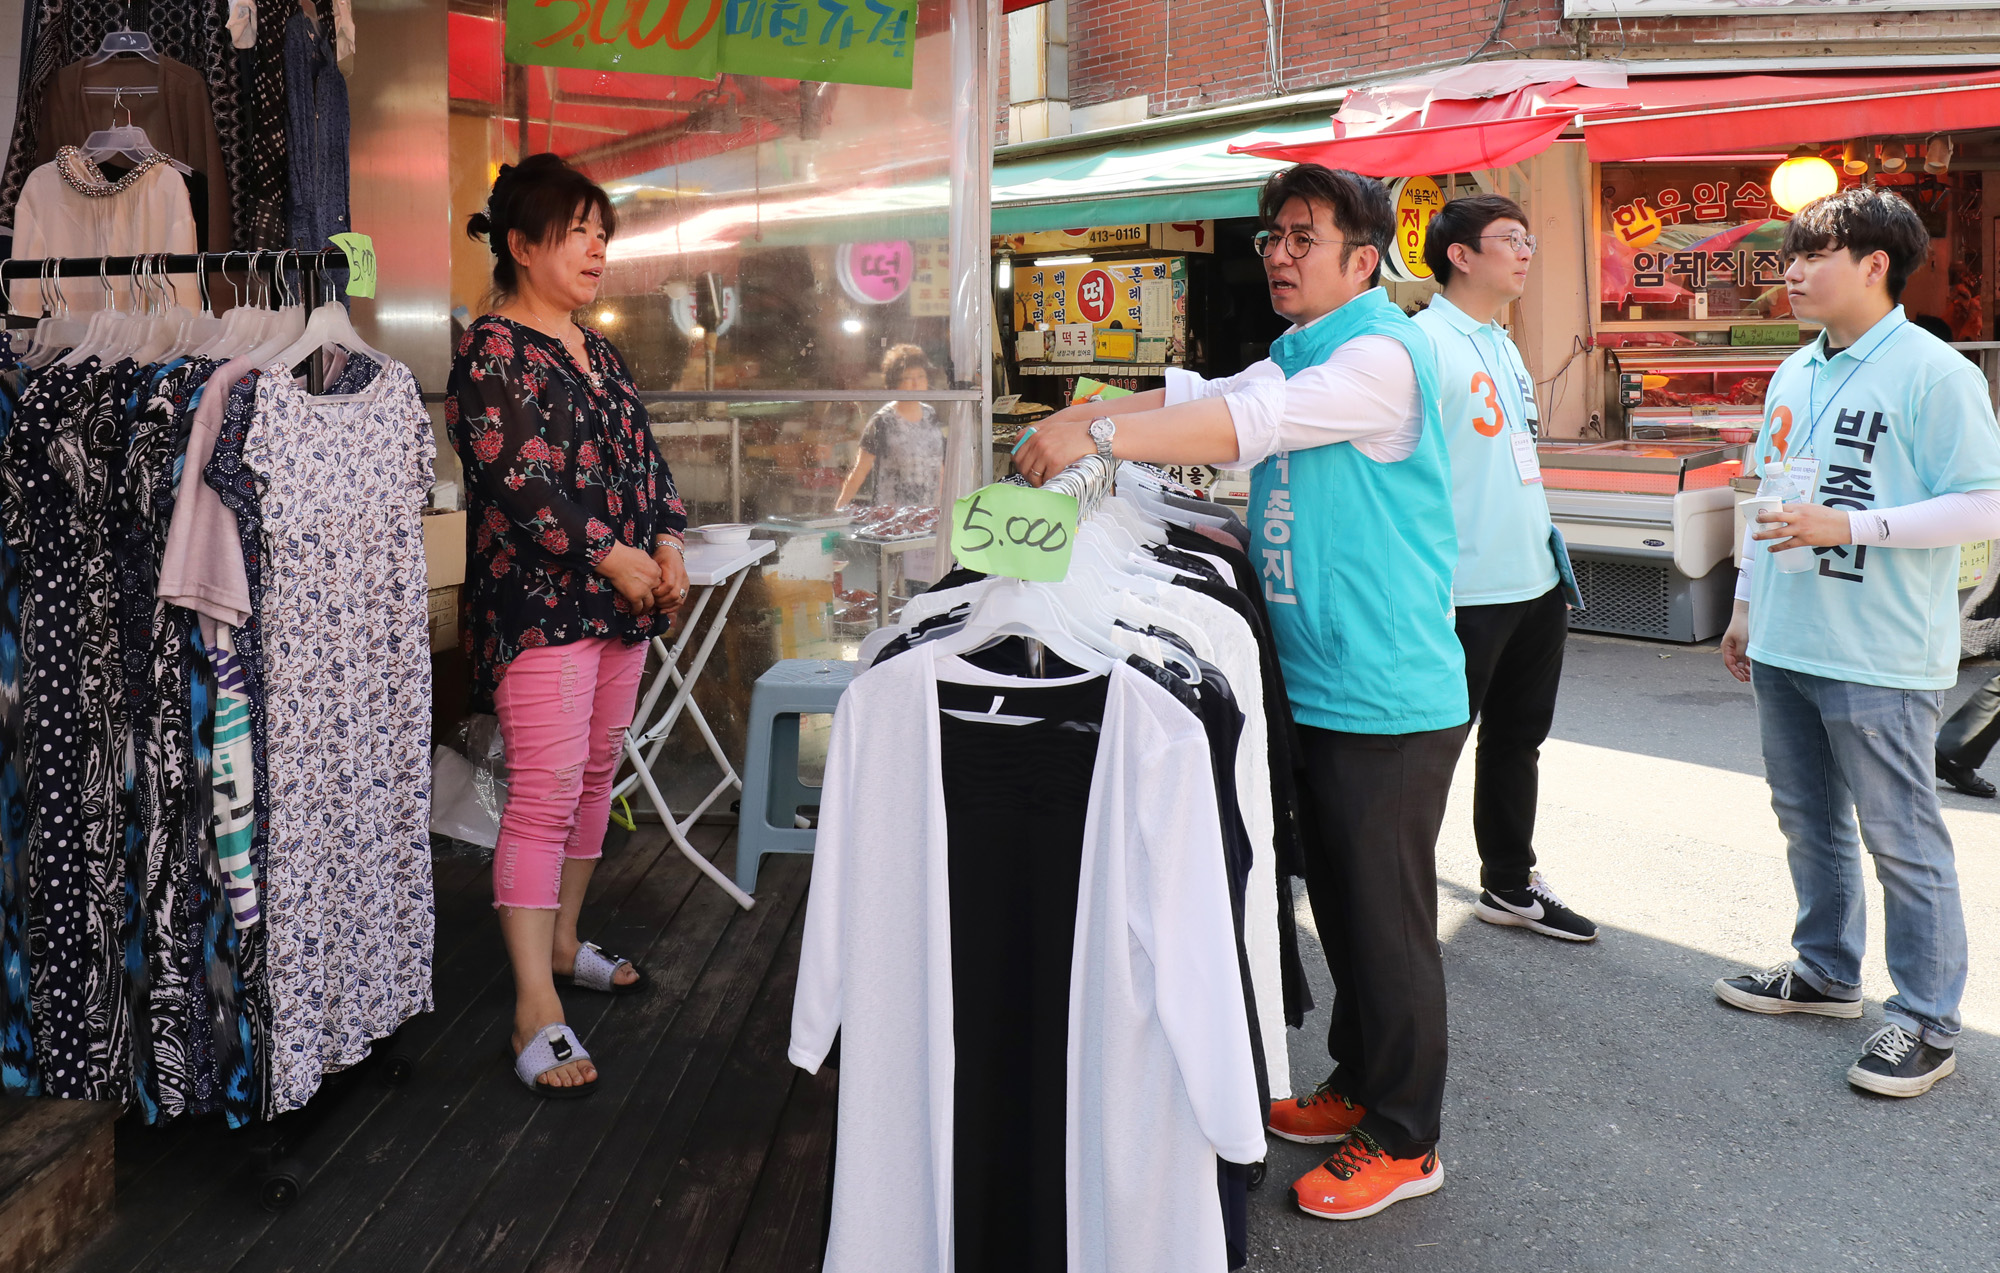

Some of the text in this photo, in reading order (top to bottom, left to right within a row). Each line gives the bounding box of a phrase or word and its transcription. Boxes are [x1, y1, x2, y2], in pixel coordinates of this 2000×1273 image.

[1405, 188, 1439, 206] 서울축산
[1089, 226, 1141, 244] 413-0116
[1401, 208, 1440, 248] 정
[860, 251, 899, 291] 떡
[1031, 271, 1045, 324] 개업떡
[1053, 270, 1066, 325] 백일떡
[1082, 277, 1106, 317] 떡
[1127, 266, 1143, 325] 혼례떡
[1470, 371, 1505, 437] 3
[1169, 465, 1205, 486] 서울
[961, 495, 1067, 552] 5.000
